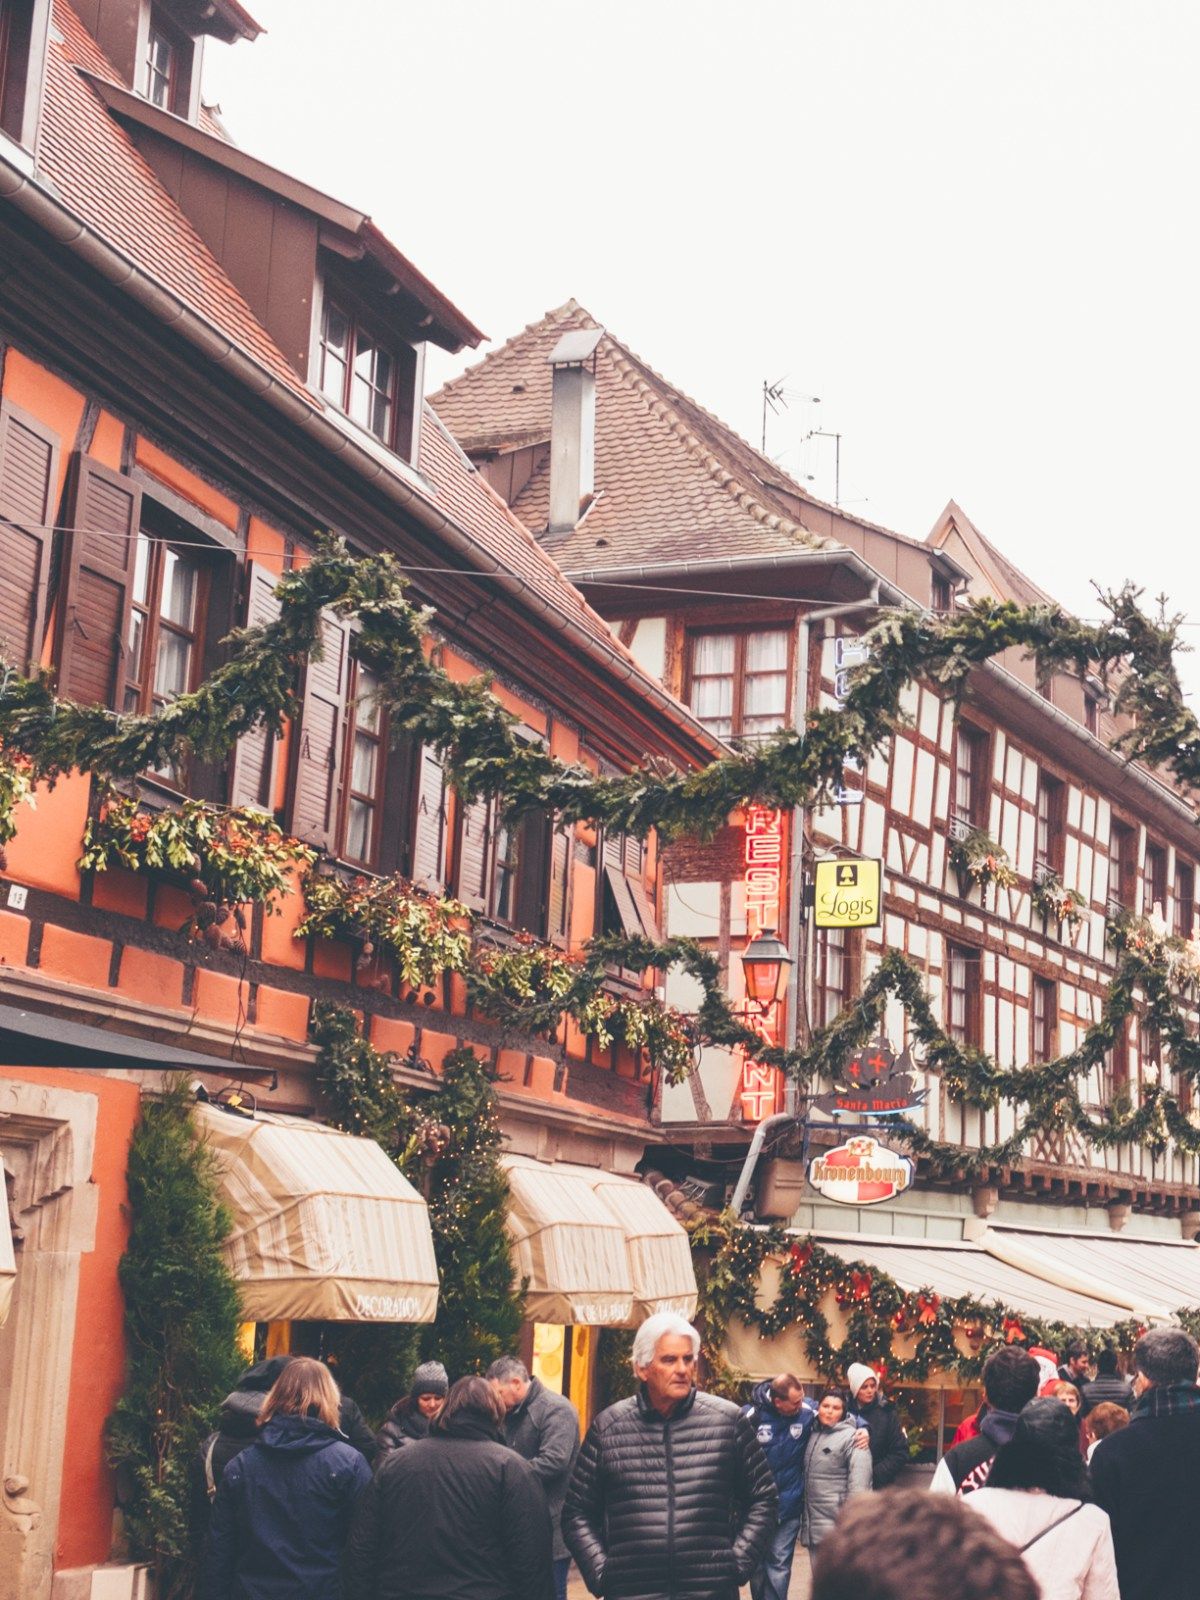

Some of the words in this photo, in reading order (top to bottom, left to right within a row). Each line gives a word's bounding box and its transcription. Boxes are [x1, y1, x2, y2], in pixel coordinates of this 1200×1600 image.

[817, 889, 874, 922] Logis
[740, 801, 781, 1120] RESTURNT
[836, 1098, 868, 1110] Santa
[872, 1097, 908, 1110] Maria
[813, 1160, 906, 1188] Kronenbourg
